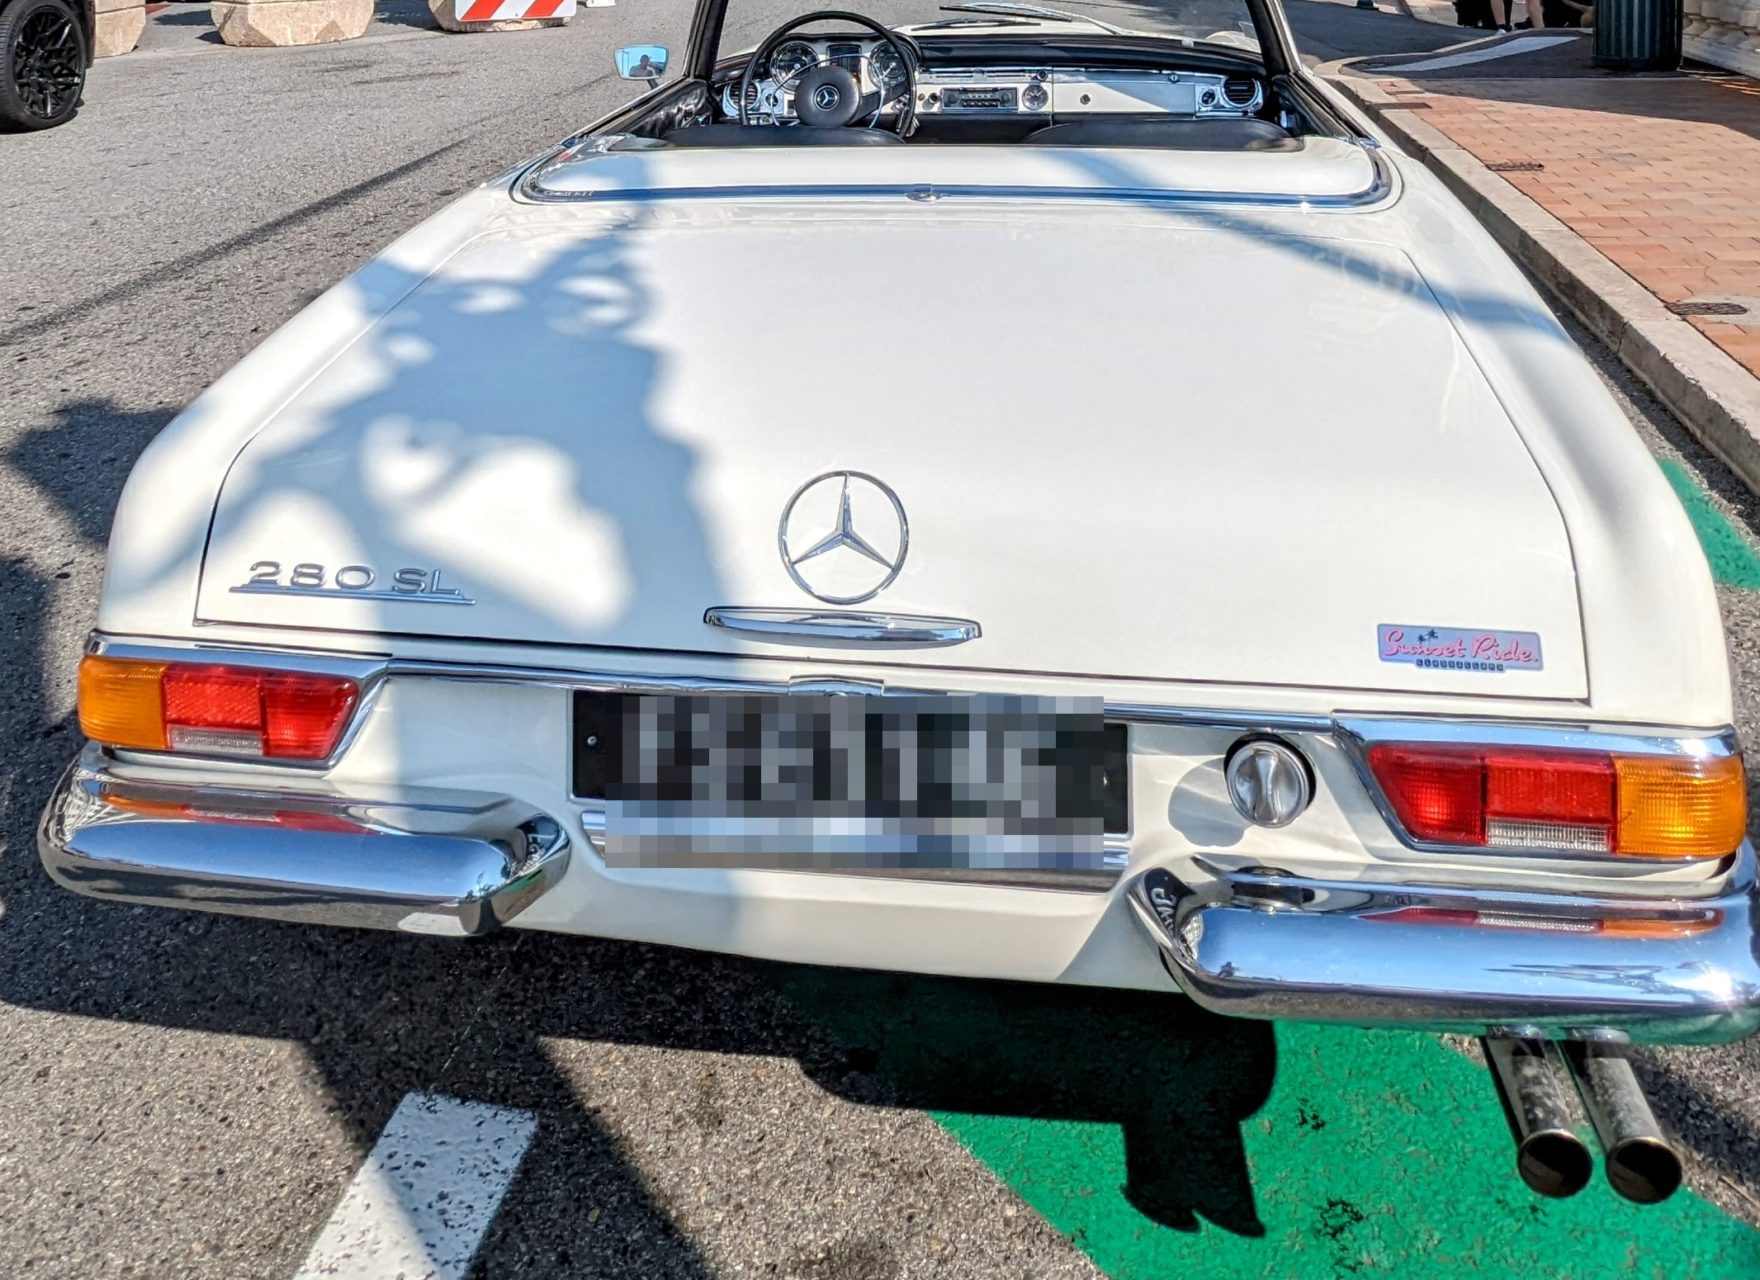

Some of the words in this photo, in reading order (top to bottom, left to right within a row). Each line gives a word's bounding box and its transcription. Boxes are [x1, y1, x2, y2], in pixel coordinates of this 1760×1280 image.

[249, 560, 376, 590] 280
[391, 567, 461, 595] SL
[1384, 628, 1467, 658] Sunset
